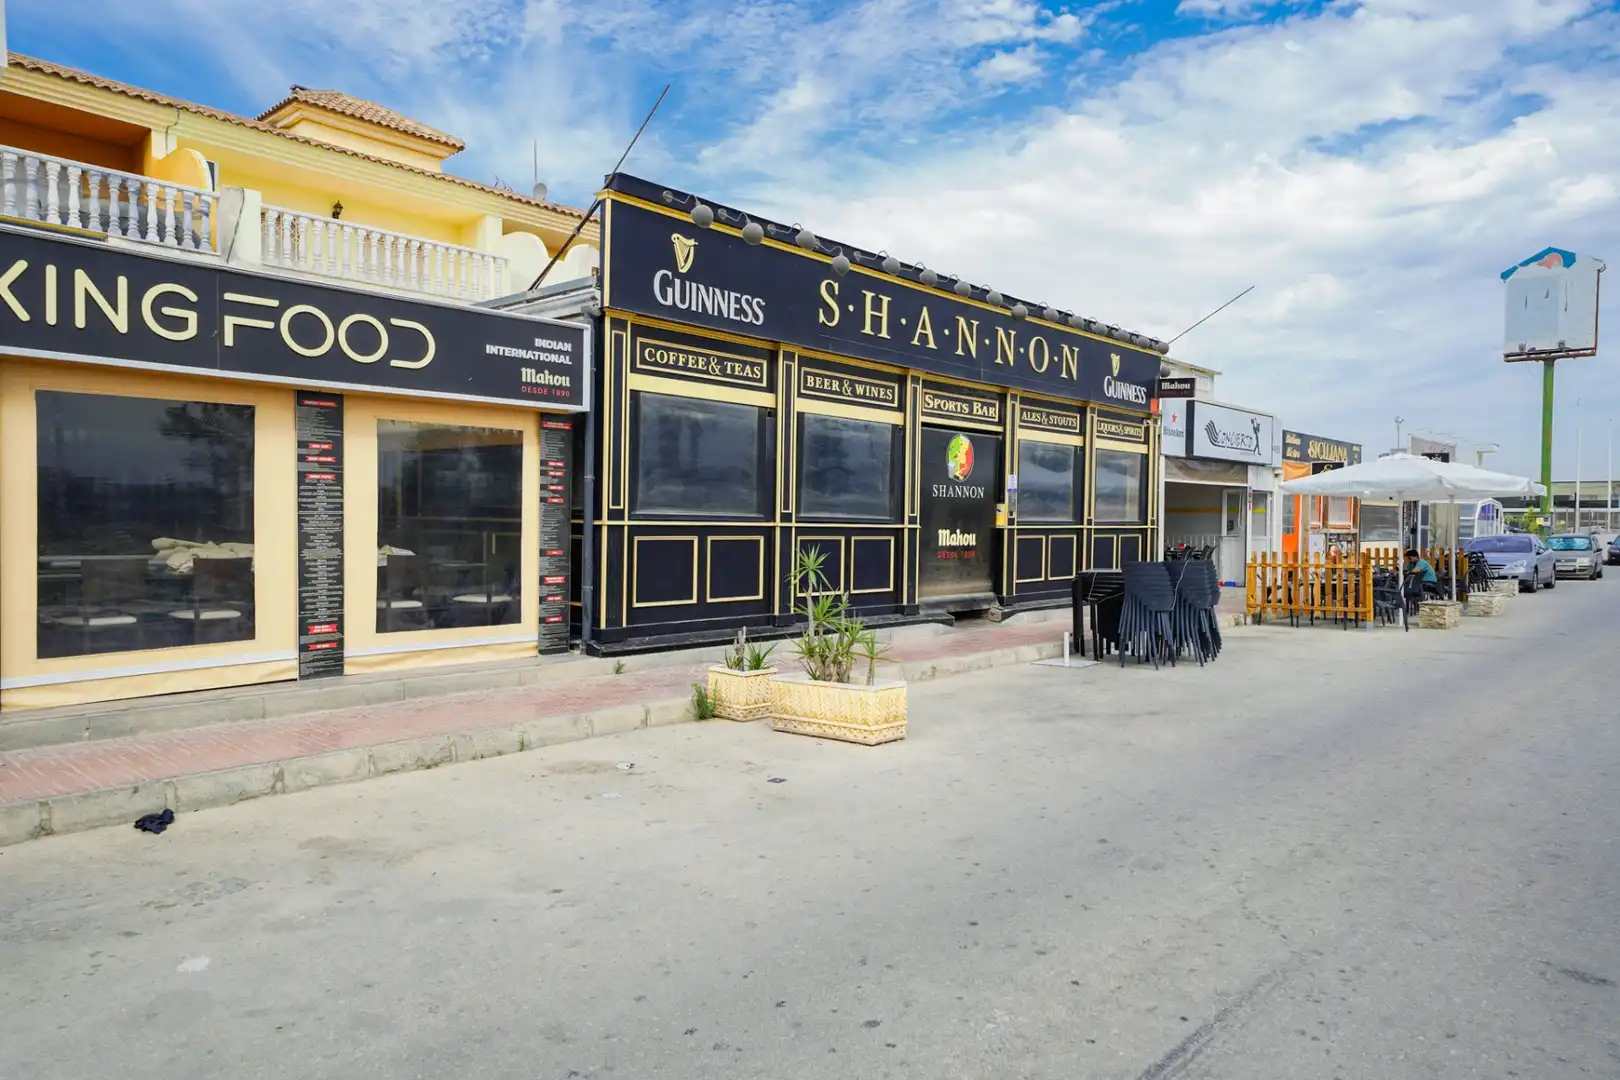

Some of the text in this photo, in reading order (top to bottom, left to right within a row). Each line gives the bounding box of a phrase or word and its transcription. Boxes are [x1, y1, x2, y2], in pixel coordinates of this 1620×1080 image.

[653, 269, 765, 326] GUINNESS
[223, 292, 436, 369] FOOD
[485, 343, 573, 365] INTERNATIONAL
[534, 337, 572, 352] INDIAN
[644, 347, 761, 379] COFFEE & TEAS
[521, 366, 571, 388] Mahou
[806, 375, 893, 400] BEER & WINES
[521, 385, 570, 398] DESDE 1890
[1103, 375, 1147, 405] GUINNESS
[924, 394, 997, 418] SPORTS BAR
[1021, 411, 1077, 428] ALES & STOUTS
[1308, 440, 1348, 462] SICILIANA
[932, 484, 985, 499] SHANNON
[937, 528, 977, 547] Mahou
